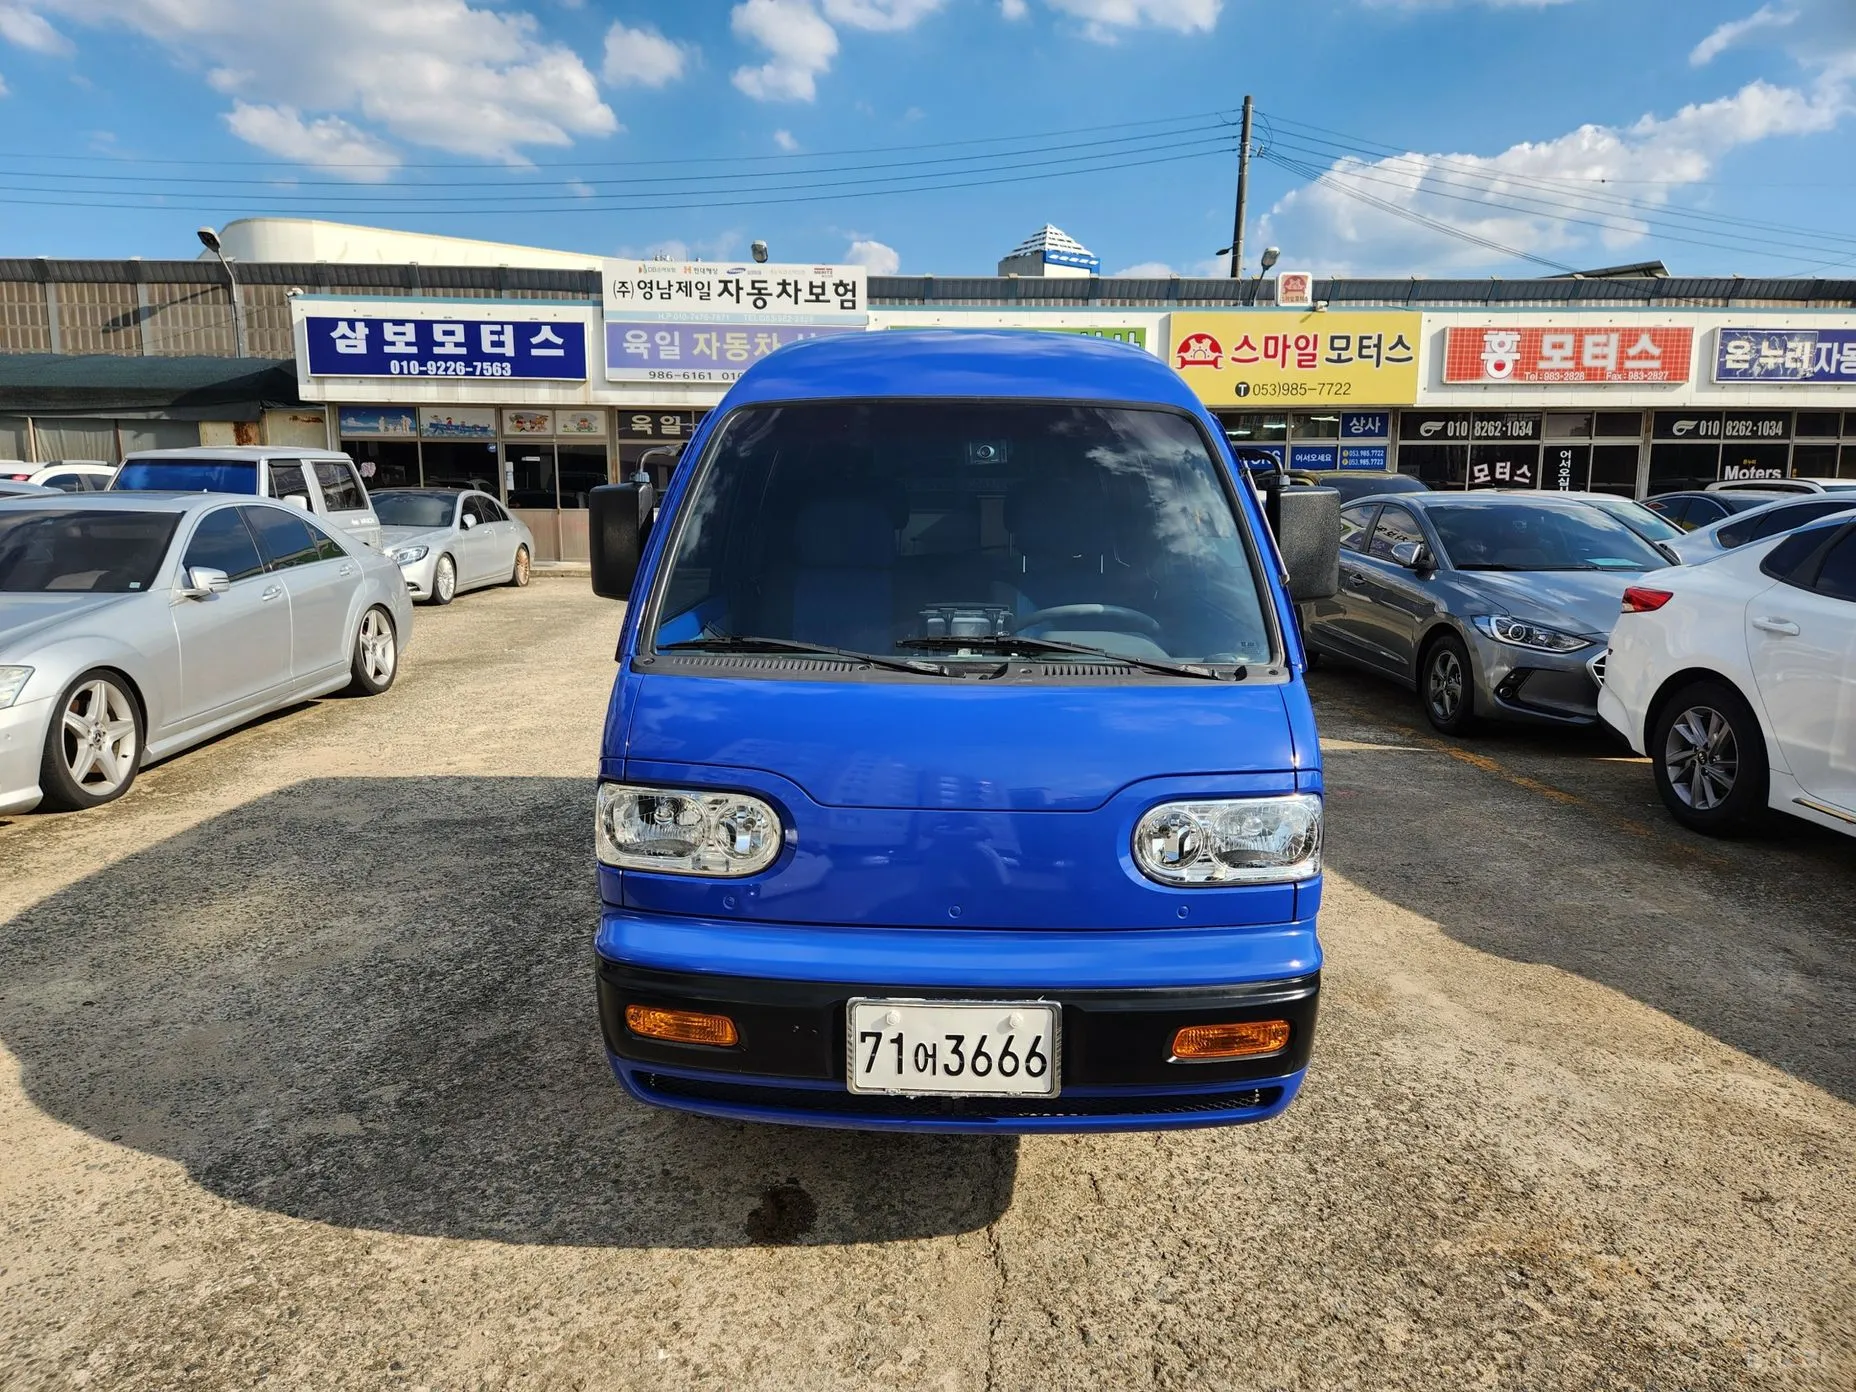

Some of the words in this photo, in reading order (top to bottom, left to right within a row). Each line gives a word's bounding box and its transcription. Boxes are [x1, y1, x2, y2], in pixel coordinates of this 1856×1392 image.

[613, 280, 712, 302] (주)영남제일
[717, 278, 857, 310] 자동차보험
[329, 320, 565, 358] 삼보모터스
[622, 330, 681, 360] 육일
[692, 331, 782, 362] 자동차
[1230, 333, 1319, 370] 스마일
[1324, 333, 1414, 370] 모터스
[1480, 330, 1521, 380] 홍
[1536, 332, 1663, 371] 모터스
[389, 359, 512, 377] 010-9226-7563
[648, 370, 713, 380] 986-6161
[1252, 382, 1352, 398] 053)985-7722
[631, 414, 681, 435] 육일
[1349, 416, 1382, 434] 상사
[1446, 420, 1469, 438] 010
[1698, 420, 1721, 437] 010
[1295, 453, 1333, 463] 어서오세요
[1472, 461, 1533, 485] 모터스
[1724, 465, 1782, 481] Moters
[860, 1031, 1047, 1078] 71어3666
